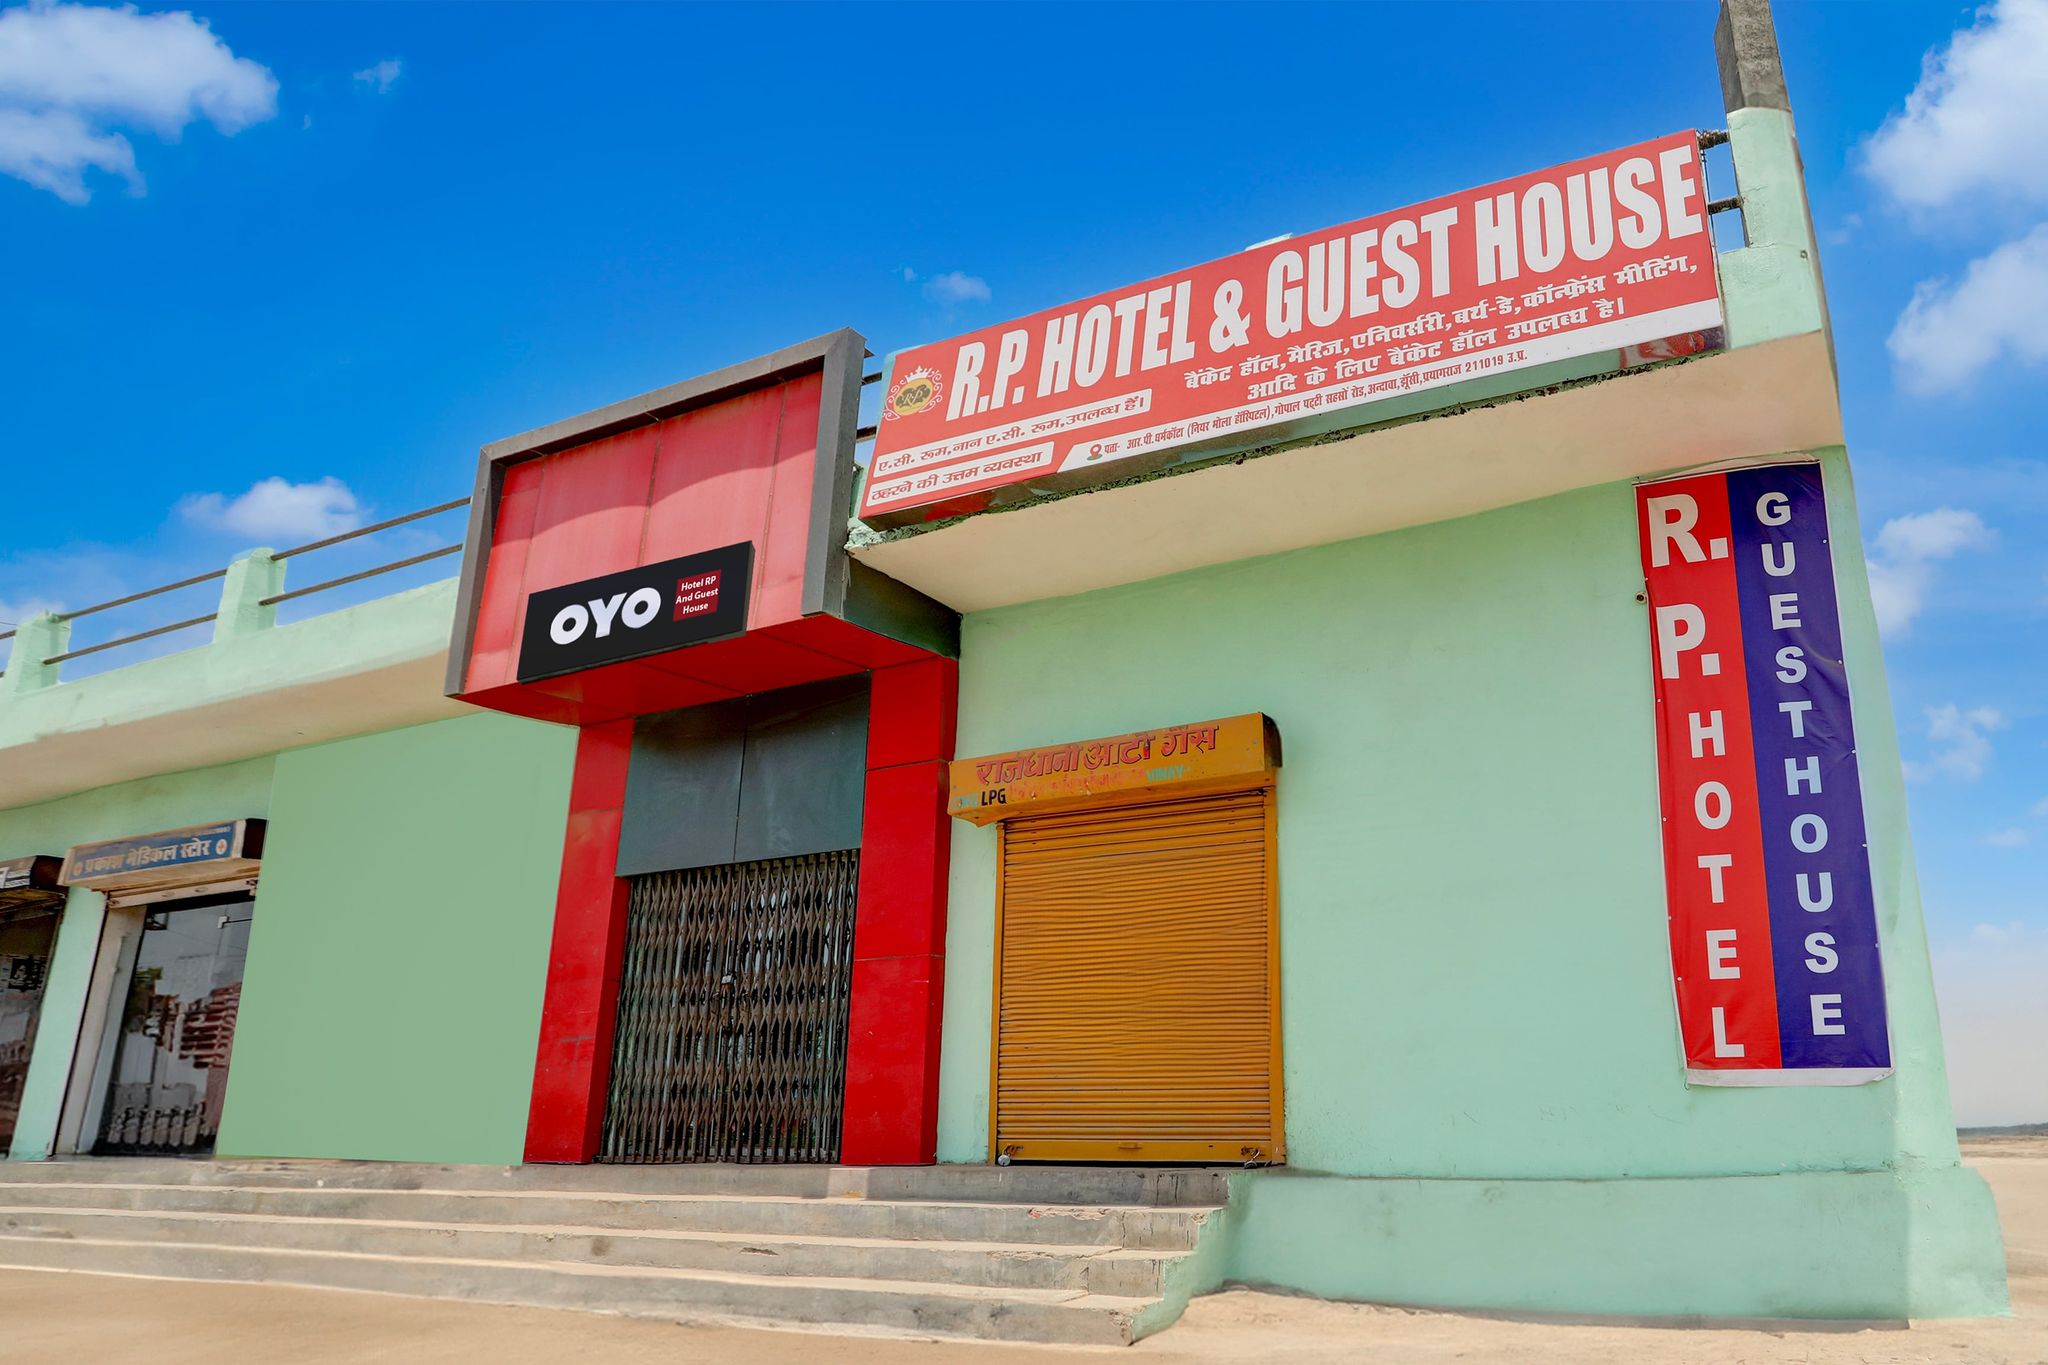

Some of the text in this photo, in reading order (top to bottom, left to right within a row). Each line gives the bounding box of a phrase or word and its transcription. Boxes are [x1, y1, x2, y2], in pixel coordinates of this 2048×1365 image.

[945, 144, 1704, 421] R.P. HOTEL & GUEST HOUSE
[1247, 372, 1297, 400] आदि
[1304, 366, 1328, 386] के
[1335, 355, 1381, 380] लिए
[1449, 327, 1498, 352] हॉल
[1465, 355, 1504, 373] 211019
[871, 480, 913, 501] ठहरने
[916, 473, 938, 489] की
[942, 466, 979, 484] उत्तम
[676, 587, 719, 605] And Guest
[681, 575, 717, 591] Hotel RP
[550, 587, 662, 645] OYO
[682, 602, 709, 615] House
[981, 788, 1007, 806] LPG
[1688, 709, 1745, 1058] HOTEL
